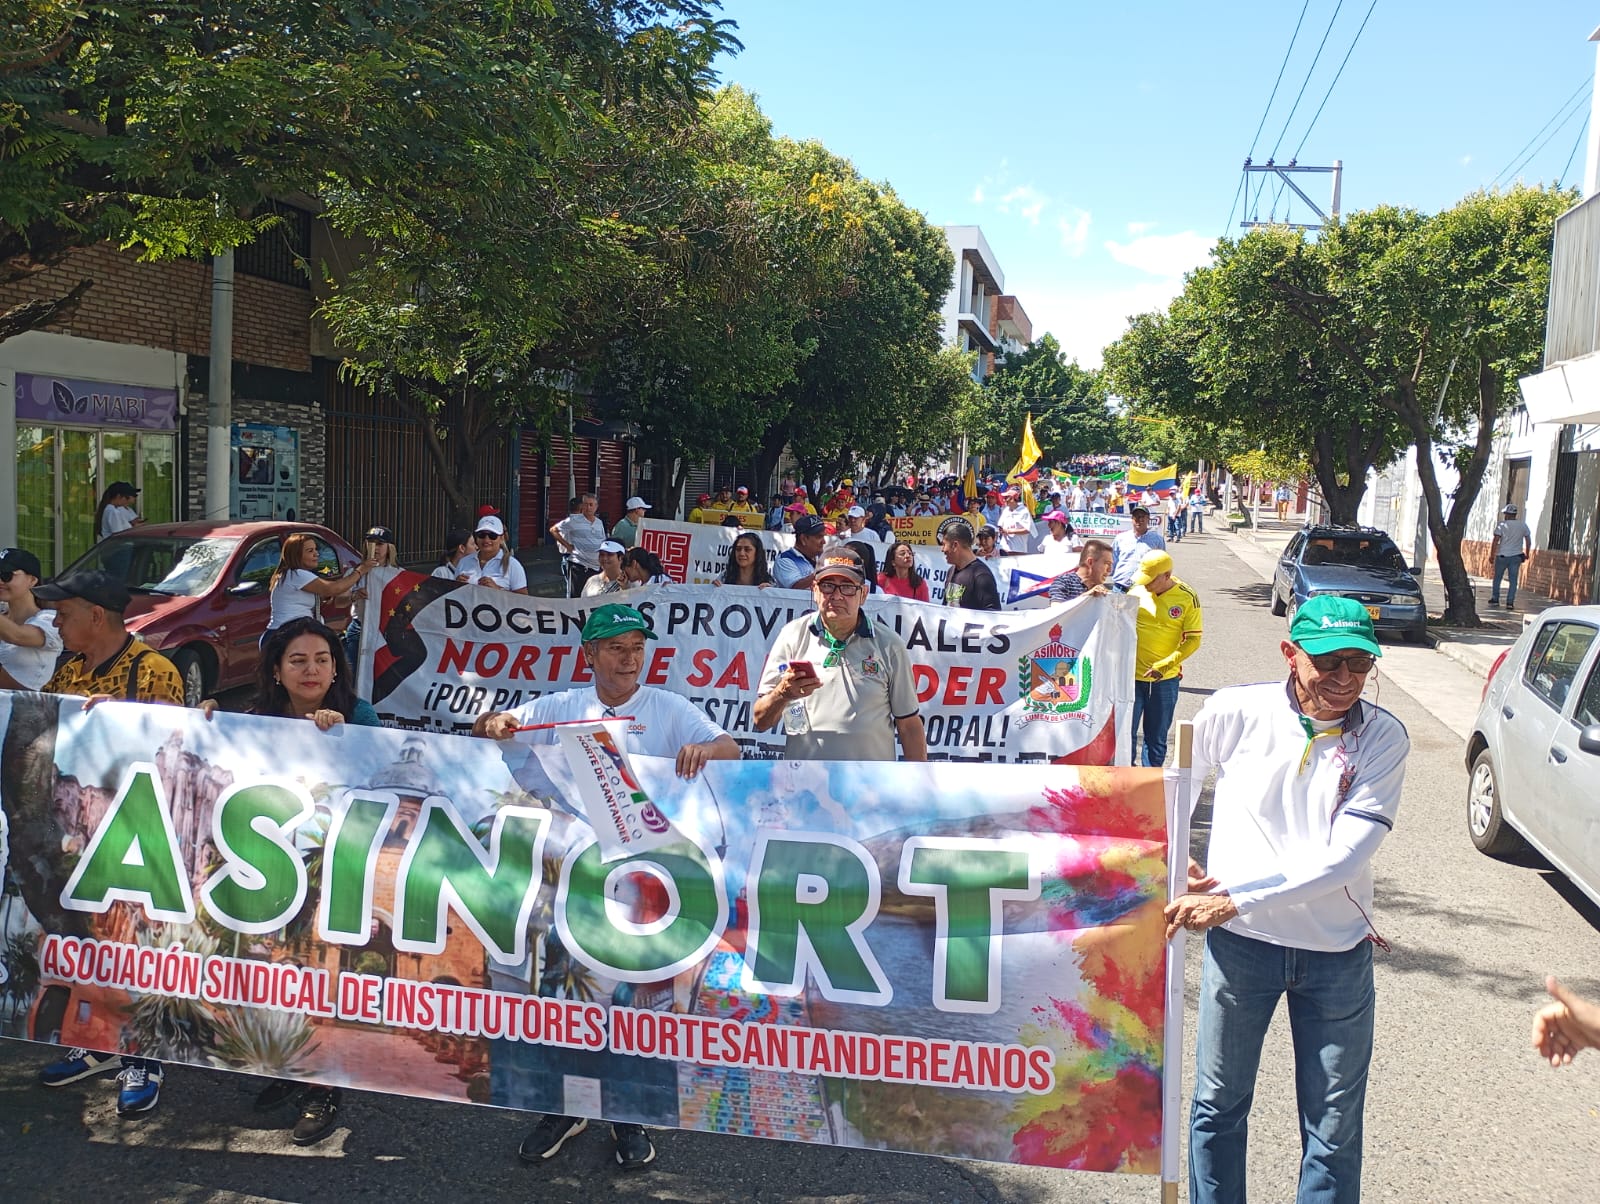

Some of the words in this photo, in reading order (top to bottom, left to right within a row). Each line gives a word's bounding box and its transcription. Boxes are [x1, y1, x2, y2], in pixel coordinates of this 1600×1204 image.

[92, 394, 146, 419] MABI
[703, 561, 712, 573] LA
[445, 599, 655, 635] DOCENS
[437, 638, 593, 682] NORTE
[686, 649, 1007, 705] SADER
[1034, 643, 1077, 658] ASINORT
[576, 735, 599, 767] NORTE
[594, 766, 606, 781] DE
[600, 781, 631, 844] SANTANDER
[60, 762, 1041, 1013] ASINORT
[43, 938, 198, 996] ASOCIACIÓN
[204, 958, 334, 1014] SINDICAL
[342, 978, 377, 1021] DE
[386, 983, 604, 1048] INSTITUTORES
[613, 1008, 1053, 1092] NORTESANTANDEREANOS
